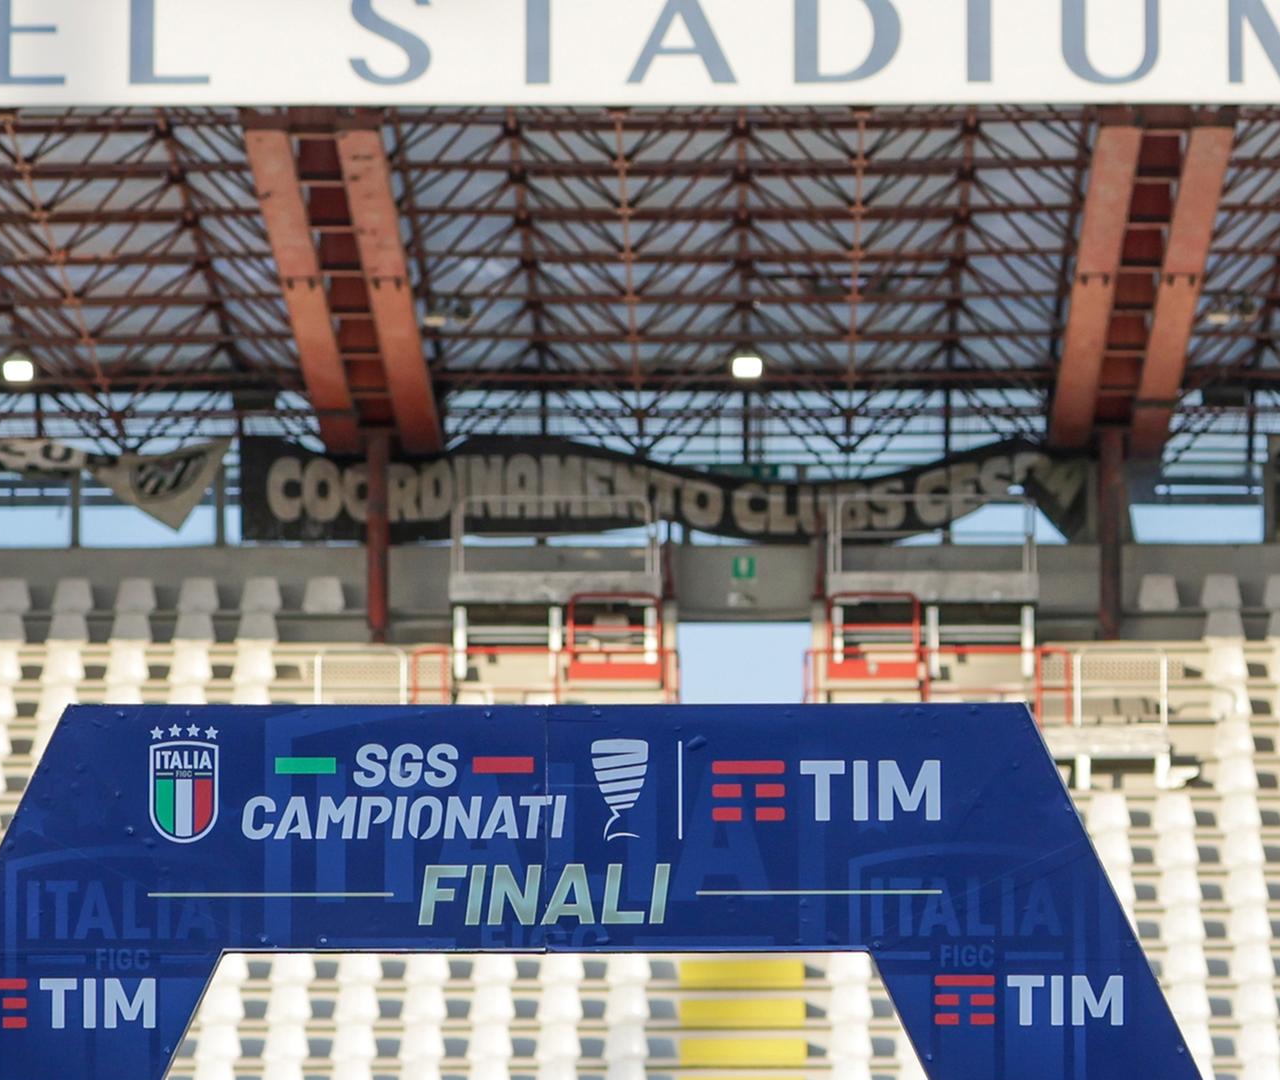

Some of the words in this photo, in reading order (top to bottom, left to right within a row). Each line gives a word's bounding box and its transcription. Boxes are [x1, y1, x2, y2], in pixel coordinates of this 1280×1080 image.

[155, 750, 212, 770] ITALIA
[353, 743, 458, 788] SGS
[800, 760, 941, 821] TIM
[241, 794, 567, 840] CAMPIONATI
[418, 863, 671, 926] FINALI
[39, 977, 156, 1029] TIM
[1007, 975, 1124, 1026] TIM
